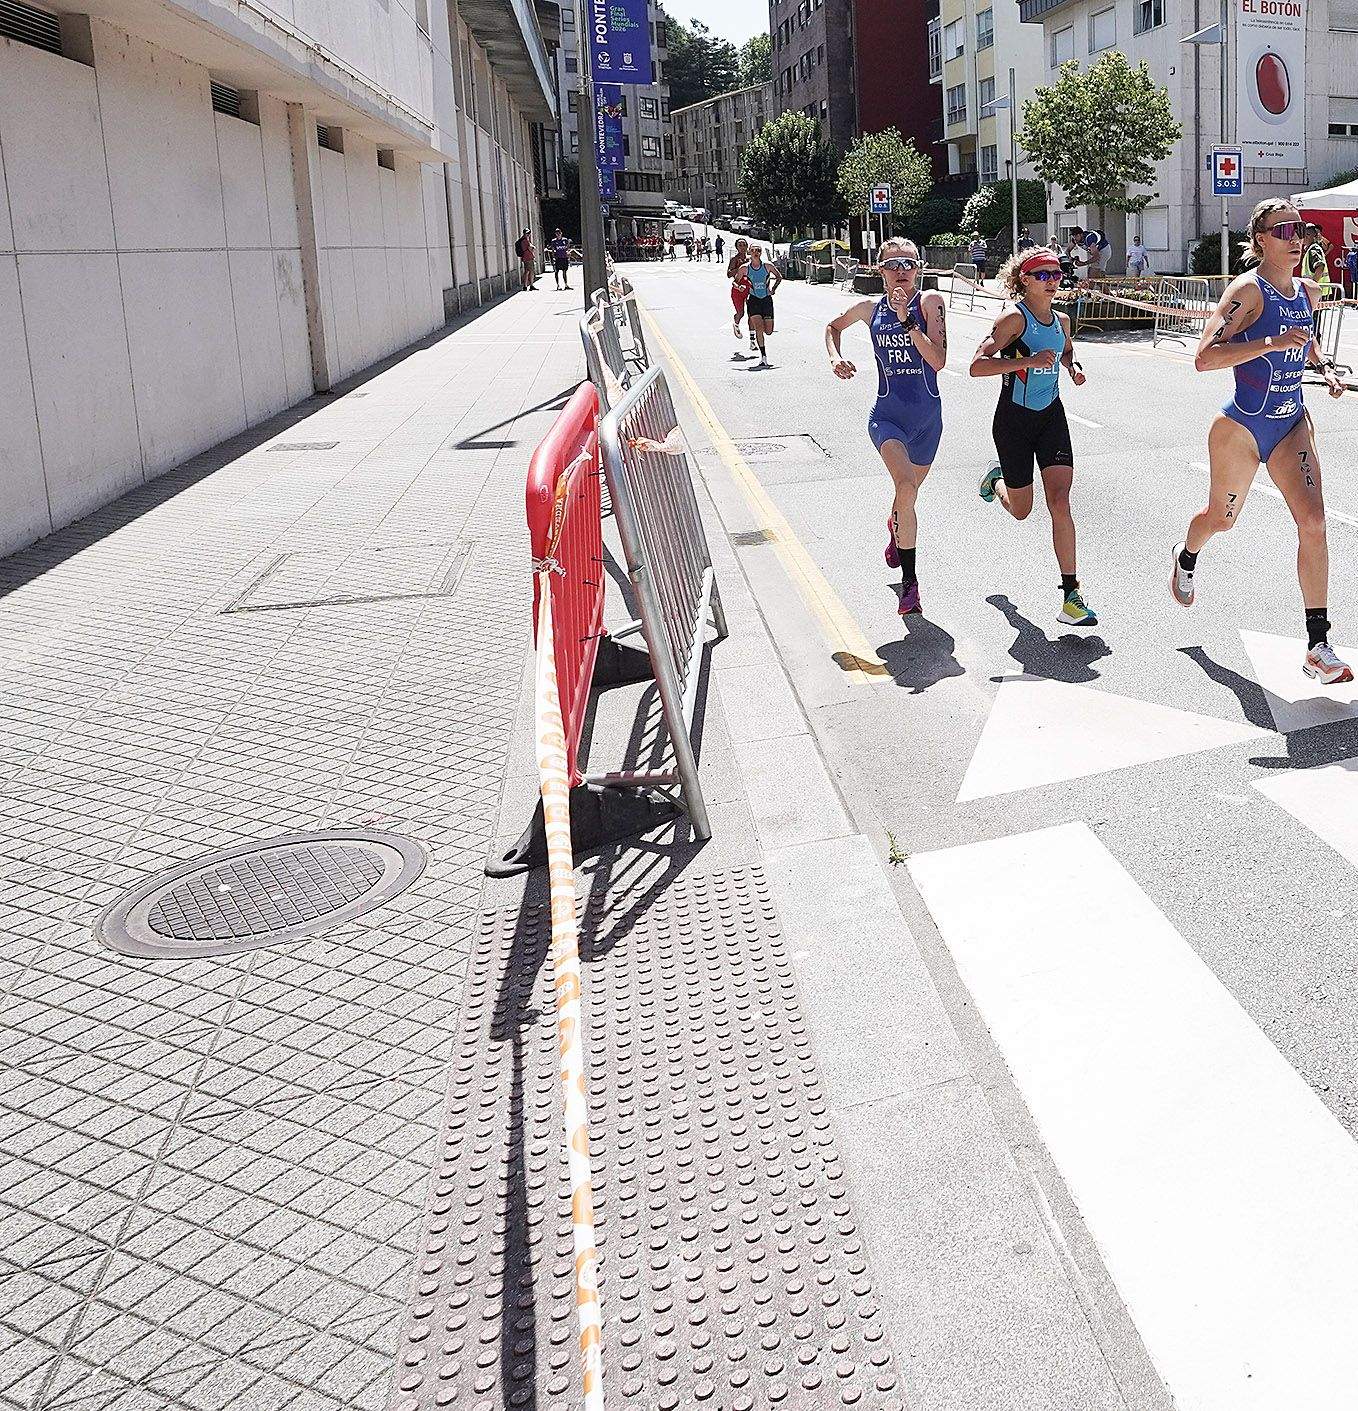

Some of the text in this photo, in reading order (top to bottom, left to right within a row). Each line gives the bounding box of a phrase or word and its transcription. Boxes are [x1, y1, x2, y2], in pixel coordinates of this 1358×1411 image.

[1242, 0, 1301, 17] EL BOTÓN
[1216, 180, 1239, 188] S.O.S.
[1229, 300, 1242, 315] 7
[1212, 326, 1225, 339] A
[876, 333, 914, 348] WASSE
[888, 349, 913, 364] FRA
[1284, 347, 1304, 362] FRA
[1297, 451, 1307, 463] 7
[1305, 475, 1315, 488] A
[1227, 493, 1237, 503] 7
